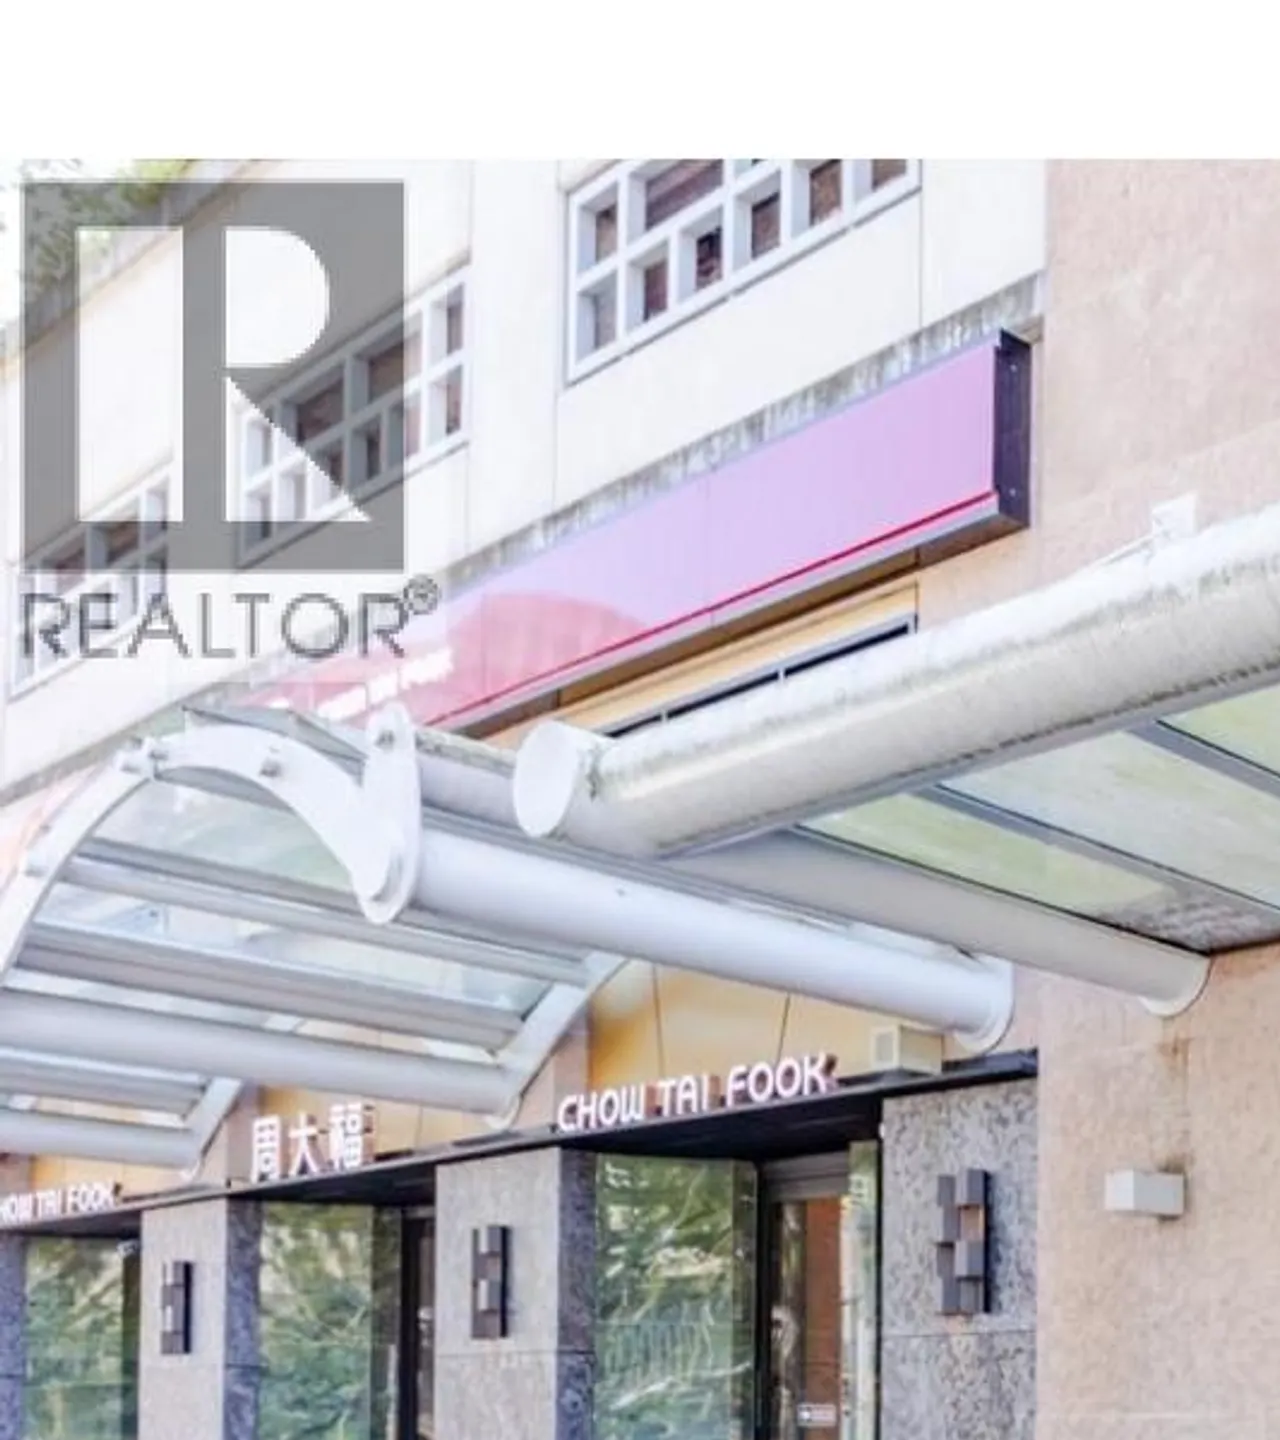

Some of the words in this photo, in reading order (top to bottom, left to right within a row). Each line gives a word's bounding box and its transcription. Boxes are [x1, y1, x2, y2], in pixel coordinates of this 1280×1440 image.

[557, 1084, 645, 1132] CHOW
[658, 1075, 709, 1117] TAI
[727, 1053, 828, 1108] FOOK
[251, 1101, 363, 1184] 周大福
[66, 1180, 116, 1215] FOOK
